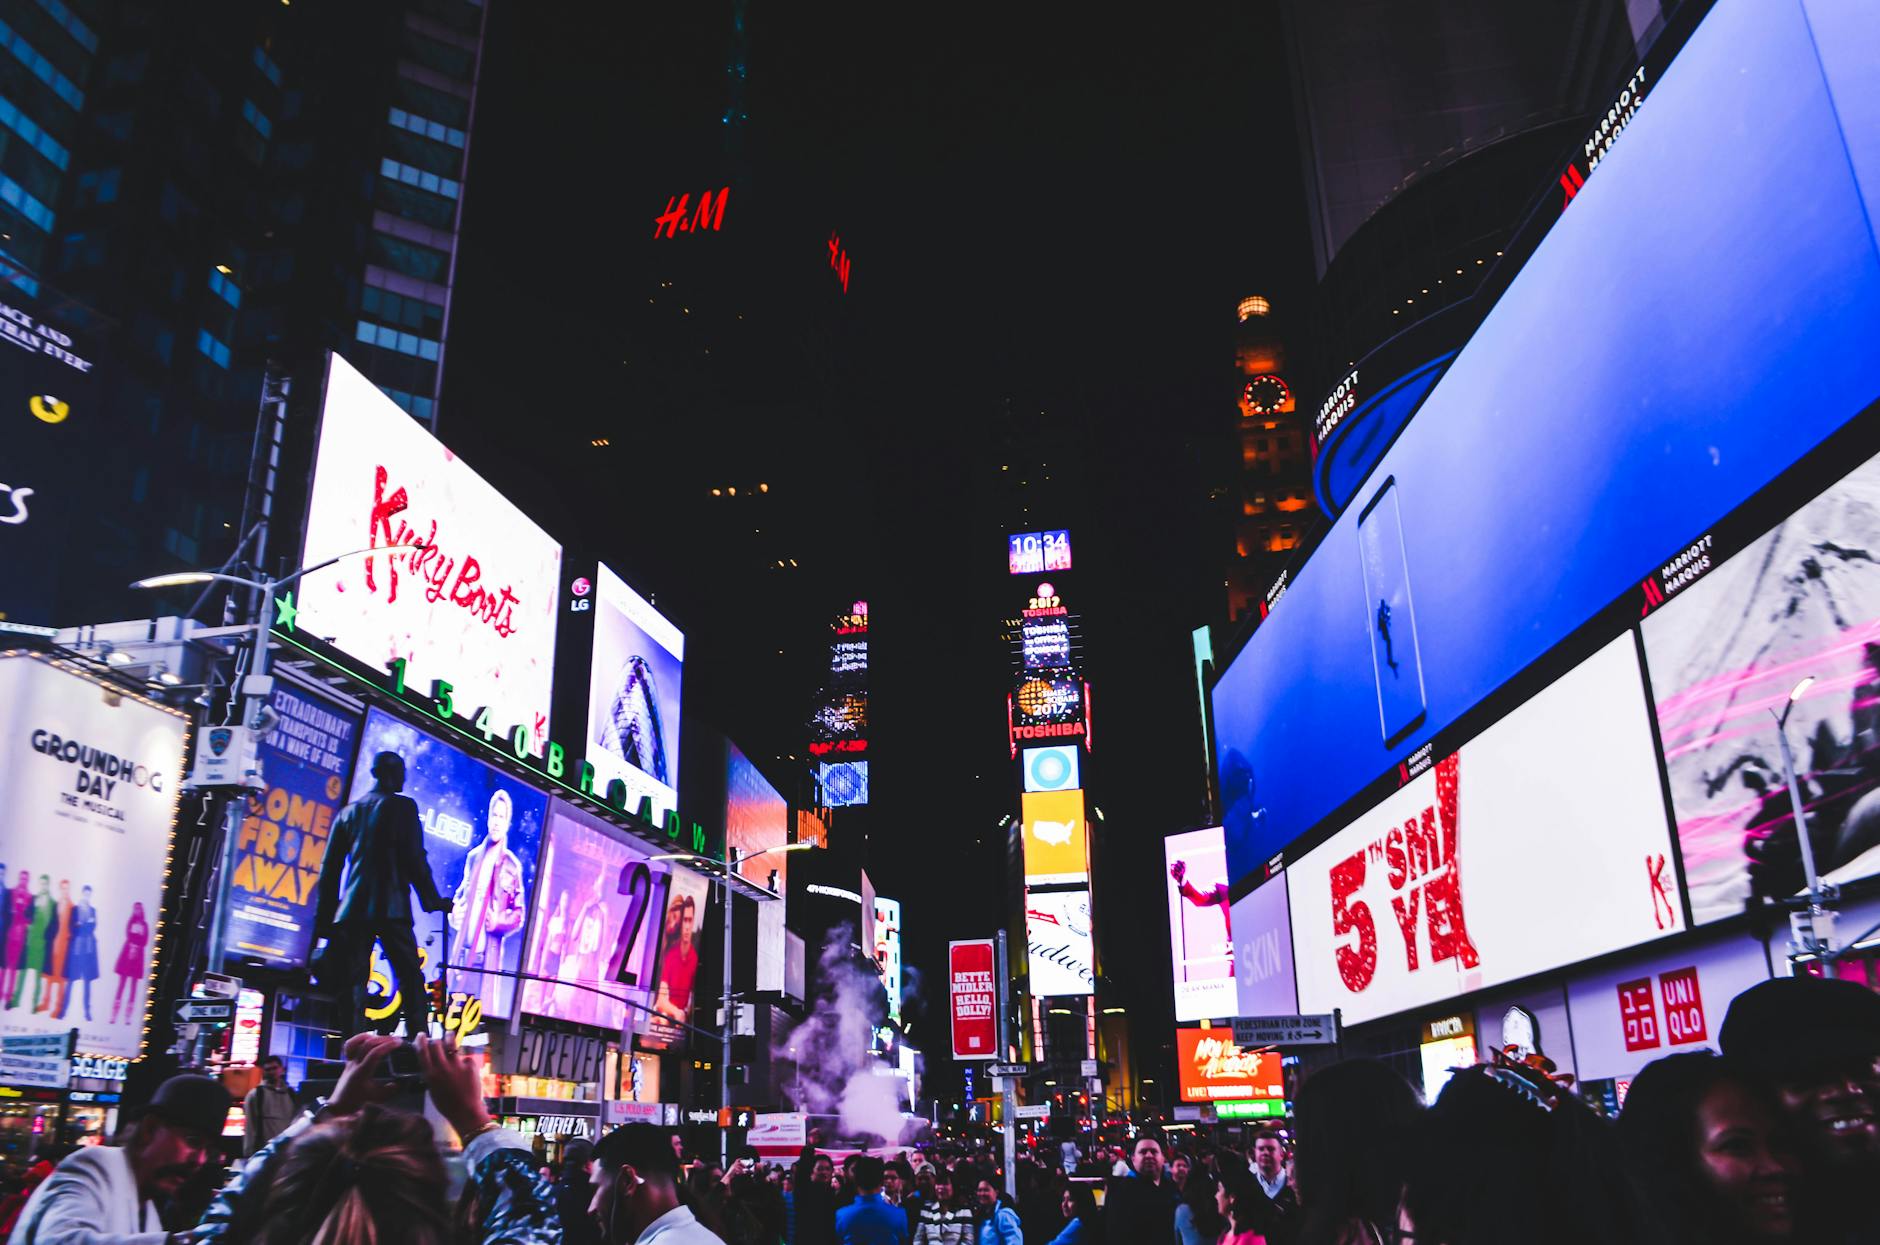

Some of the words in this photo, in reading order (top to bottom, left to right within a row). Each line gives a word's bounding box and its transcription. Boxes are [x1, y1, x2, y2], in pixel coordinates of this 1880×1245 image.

[1585, 66, 1645, 157] MARRIOTT
[654, 186, 730, 239] H&M
[36, 323, 72, 348] AND
[1316, 370, 1358, 428] MARRIOTT
[1318, 393, 1355, 445] MARQUIS
[1662, 534, 1713, 580] MARRIOTT
[1664, 555, 1711, 595] MARQUIS
[449, 554, 521, 638] Boots
[571, 599, 589, 612] LG
[1022, 606, 1068, 618] TOSHIBA
[1032, 703, 1067, 716] 2017
[1012, 722, 1085, 739] TOSHIBA
[31, 730, 163, 793] GROUNDHOG
[76, 768, 117, 802] DAY
[60, 792, 79, 808] THE
[82, 800, 125, 821] MUSICAL
[232, 853, 320, 906] AWAY
[1242, 928, 1282, 988] SKIN
[952, 982, 994, 994] MIDLER
[954, 971, 991, 983] BETTE
[1663, 976, 1695, 1007] UNI
[1668, 1006, 1702, 1040] QLO
[516, 1025, 605, 1083] FOREVER
[535, 1115, 574, 1136] FOREVER
